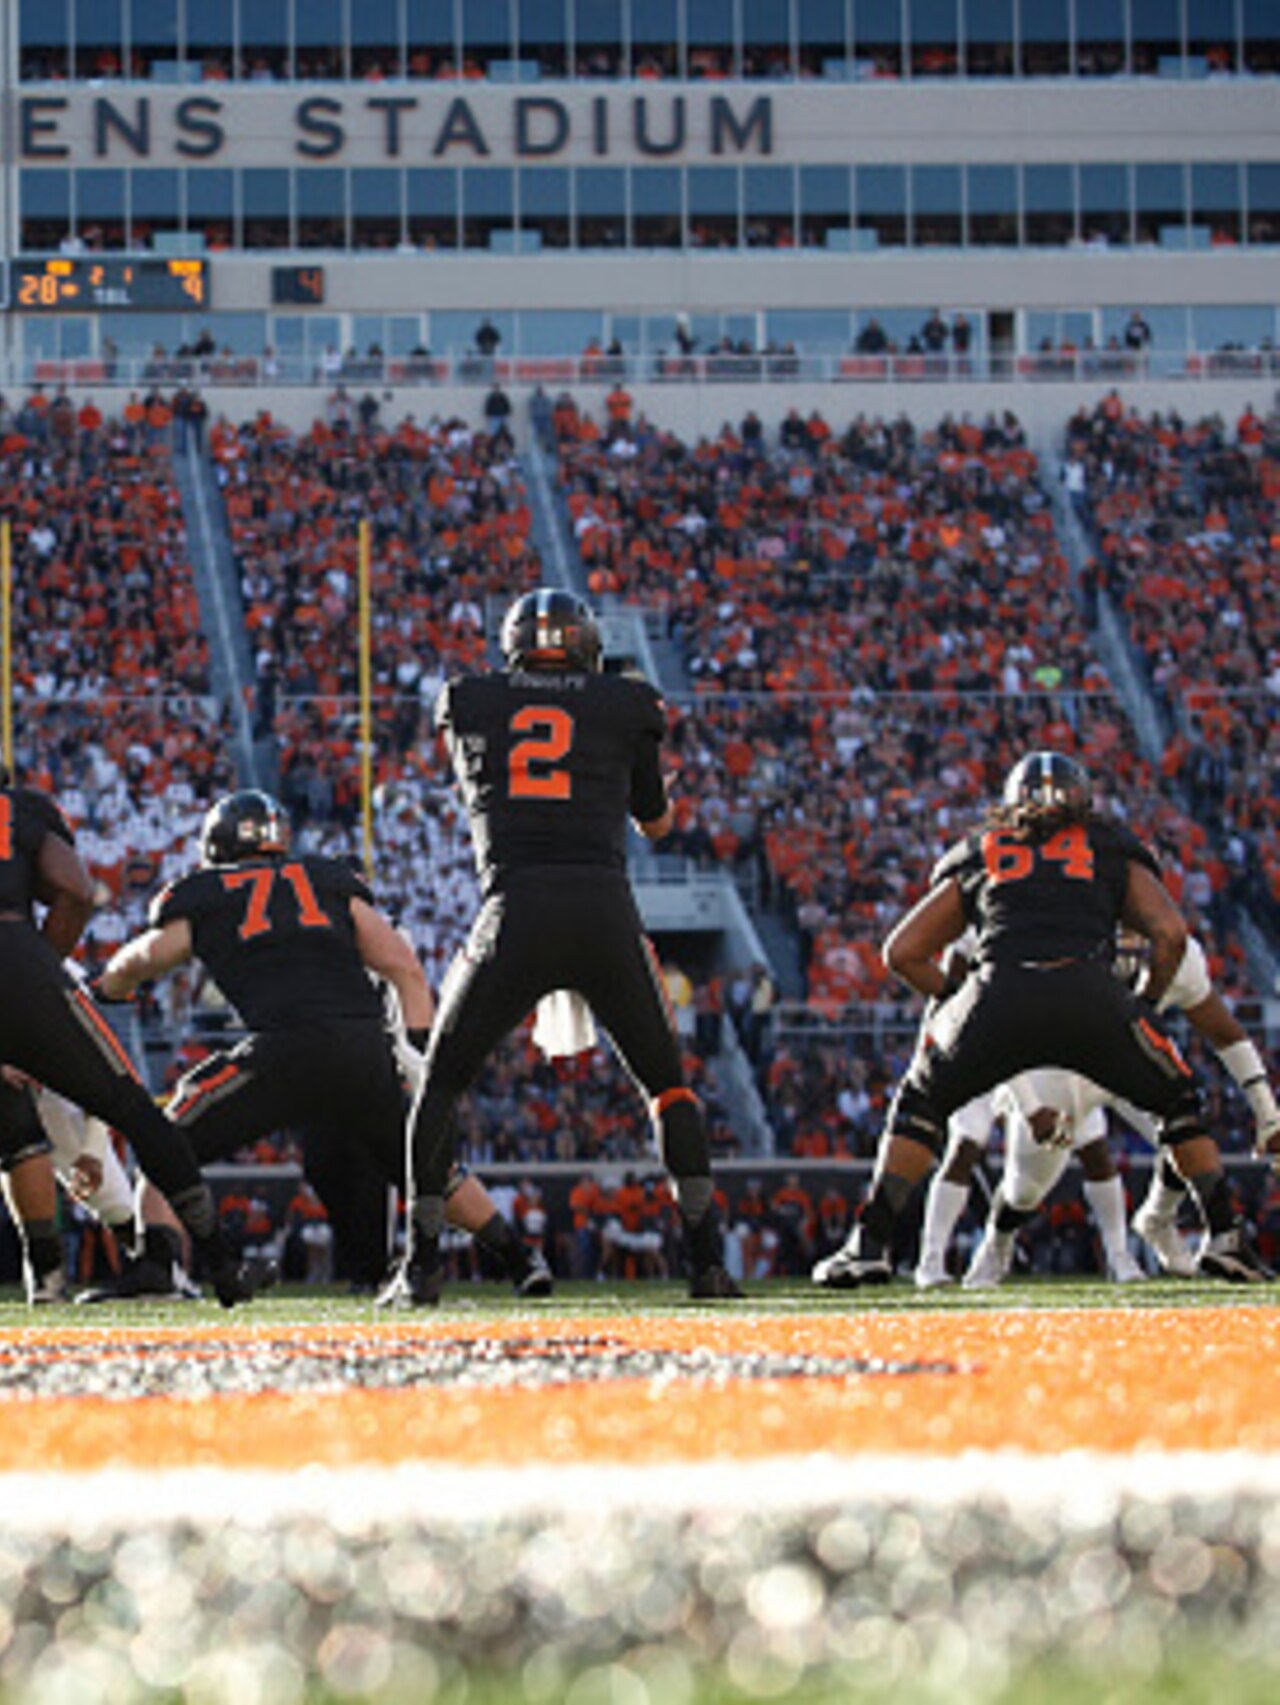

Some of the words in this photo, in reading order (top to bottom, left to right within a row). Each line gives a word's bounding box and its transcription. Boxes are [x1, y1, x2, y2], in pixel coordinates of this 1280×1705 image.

[294, 95, 775, 159] STADIUM
[508, 705, 573, 799] 2
[981, 823, 1095, 883] 64
[222, 863, 331, 940] 71
